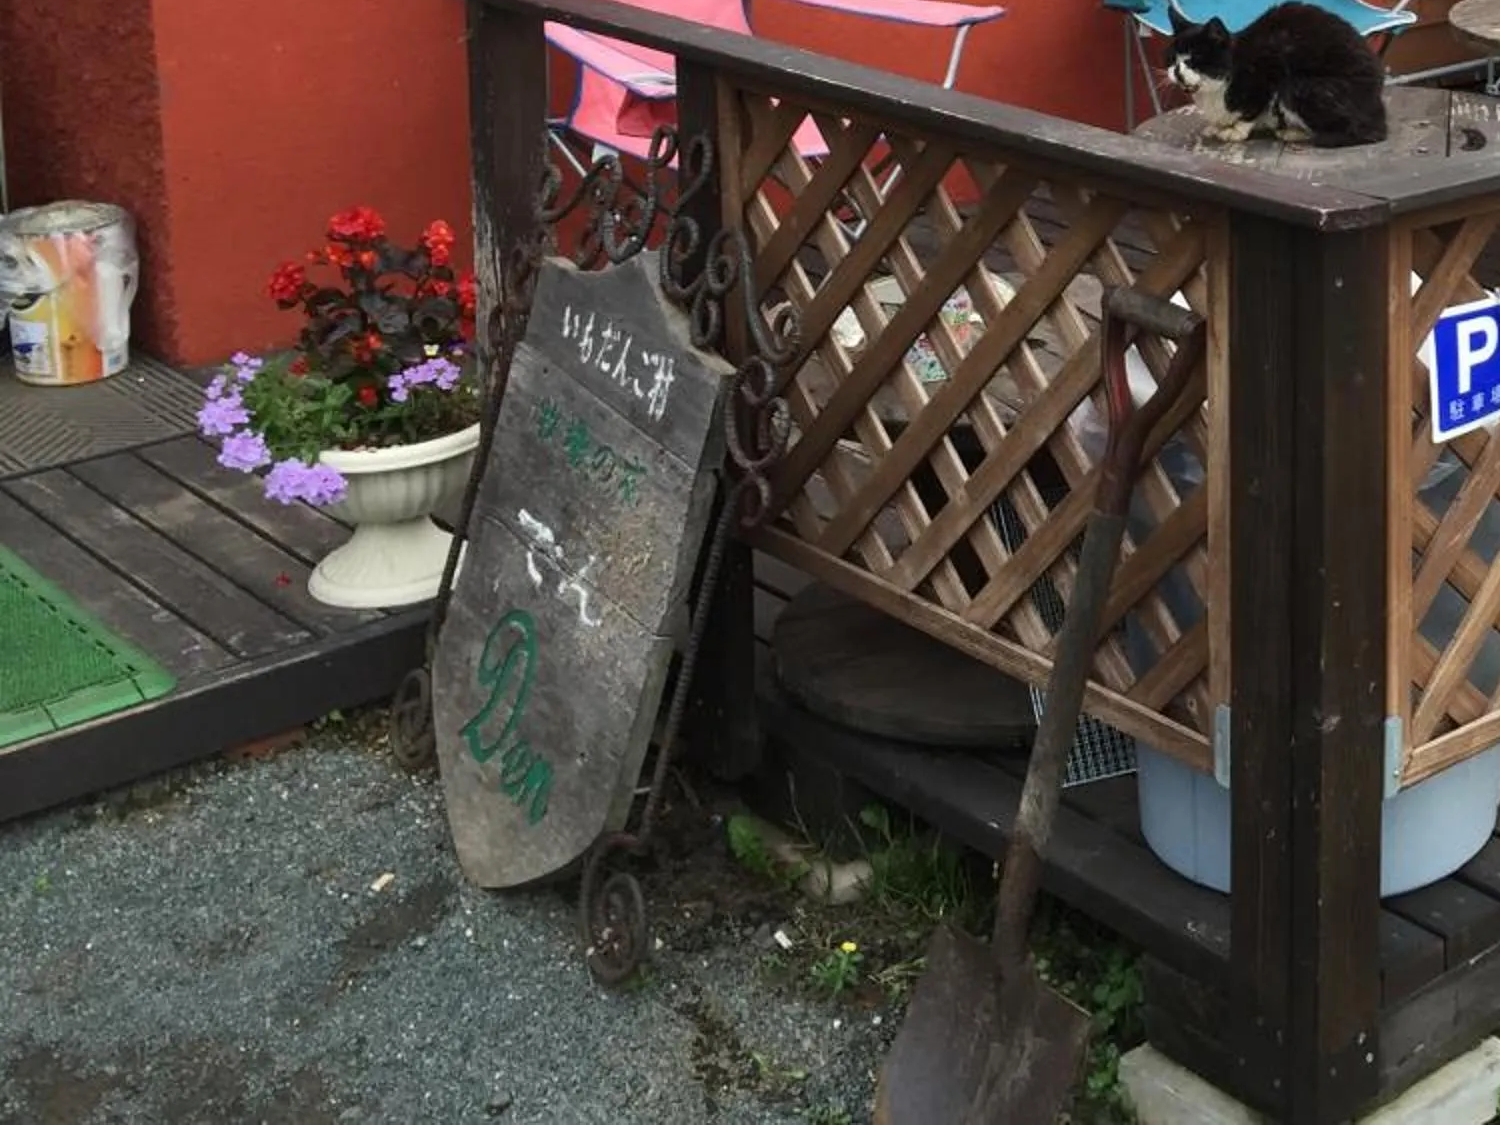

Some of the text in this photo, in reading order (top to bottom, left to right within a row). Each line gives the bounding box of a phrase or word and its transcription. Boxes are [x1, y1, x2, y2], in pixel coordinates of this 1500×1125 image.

[562, 304, 675, 422] いもだんご村
[1456, 315, 1499, 394] P
